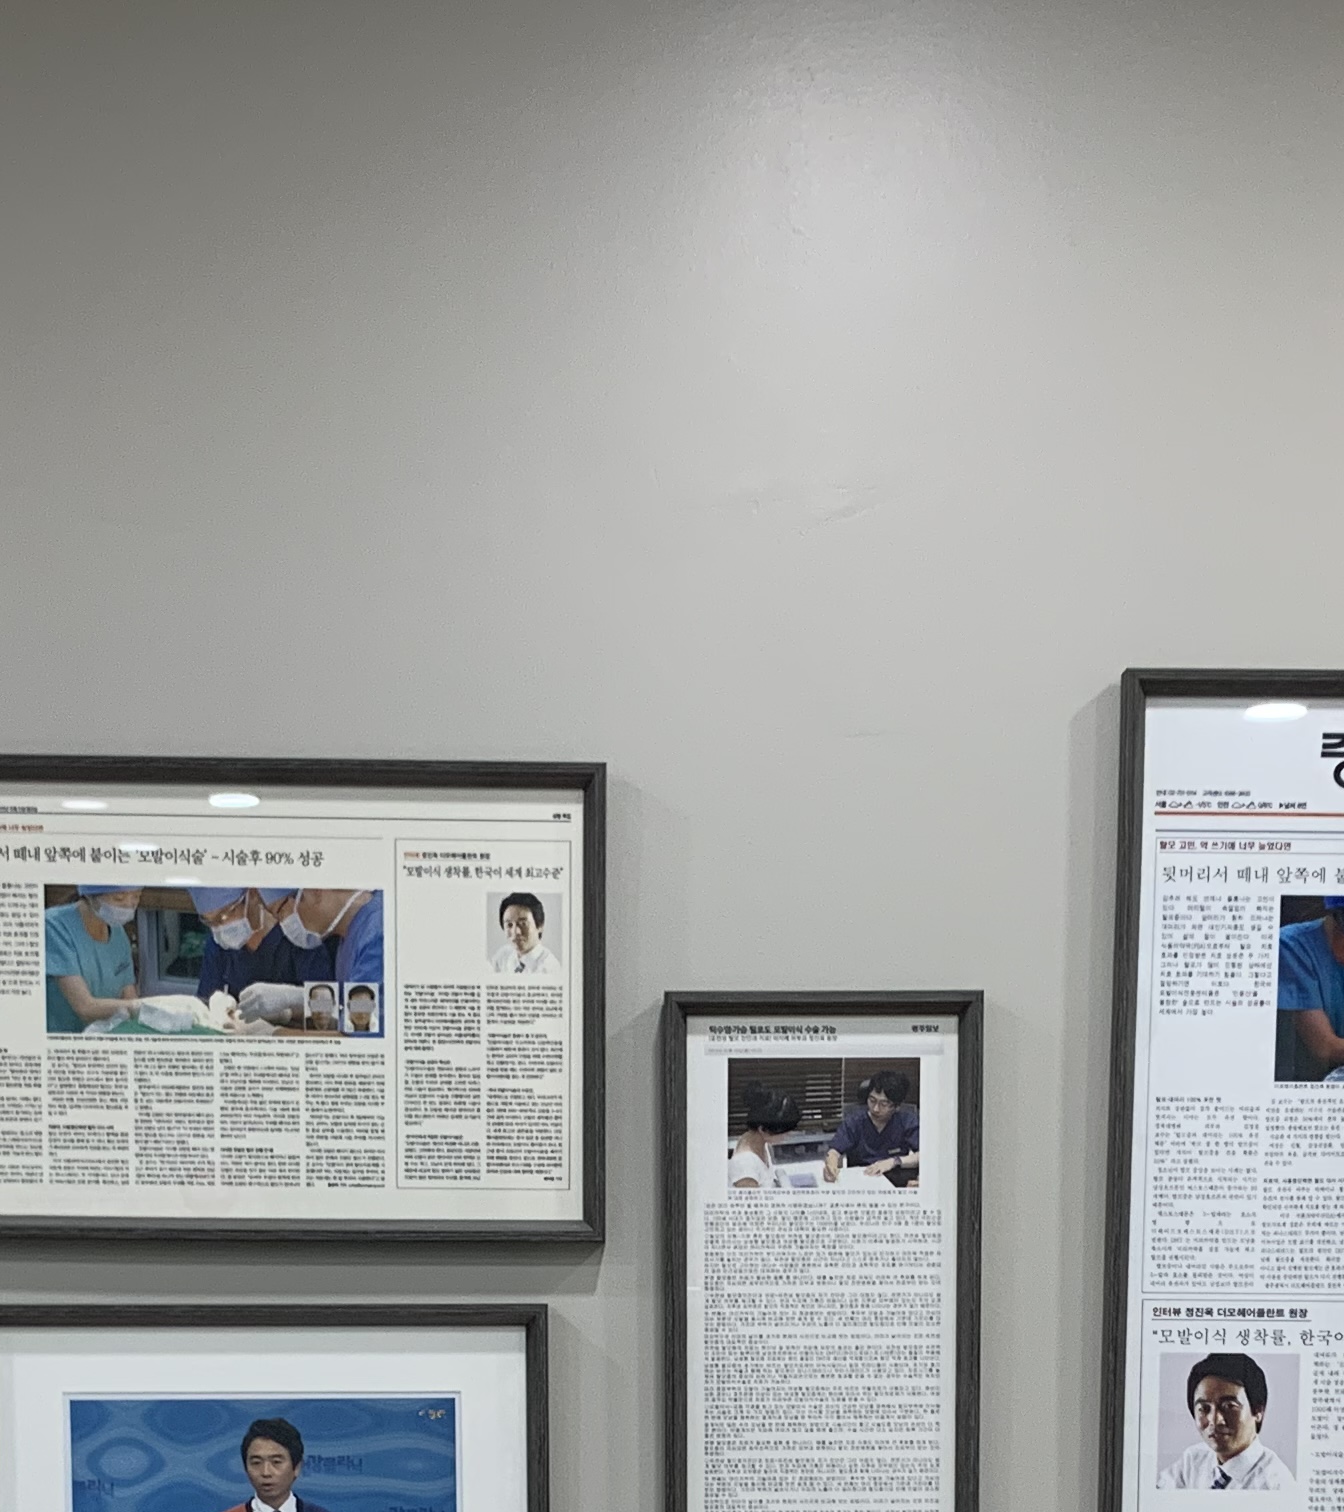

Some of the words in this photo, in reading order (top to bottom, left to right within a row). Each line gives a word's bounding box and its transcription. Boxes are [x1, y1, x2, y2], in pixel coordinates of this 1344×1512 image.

[14, 846, 40, 861] 떼내
[44, 846, 85, 863] 앞쪽에
[222, 849, 262, 866] 시술후
[265, 852, 294, 864] 90%
[299, 850, 323, 867] 성공
[475, 866, 502, 879] 한국이
[506, 867, 522, 878] 세계
[1163, 866, 1227, 882] 뒷머리서
[1237, 867, 1268, 883] 떼내
[1277, 867, 1325, 883] 앞쪽에
[821, 1025, 837, 1034] 가능
[1152, 1307, 1182, 1320] 인터뷰
[1184, 1308, 1213, 1320] 정진욱
[1216, 1308, 1286, 1321] 더모헤어플란트
[1287, 1309, 1309, 1321] 원장
[1153, 1328, 1226, 1345] "모발이식
[1236, 1329, 1290, 1346] 생착률,
